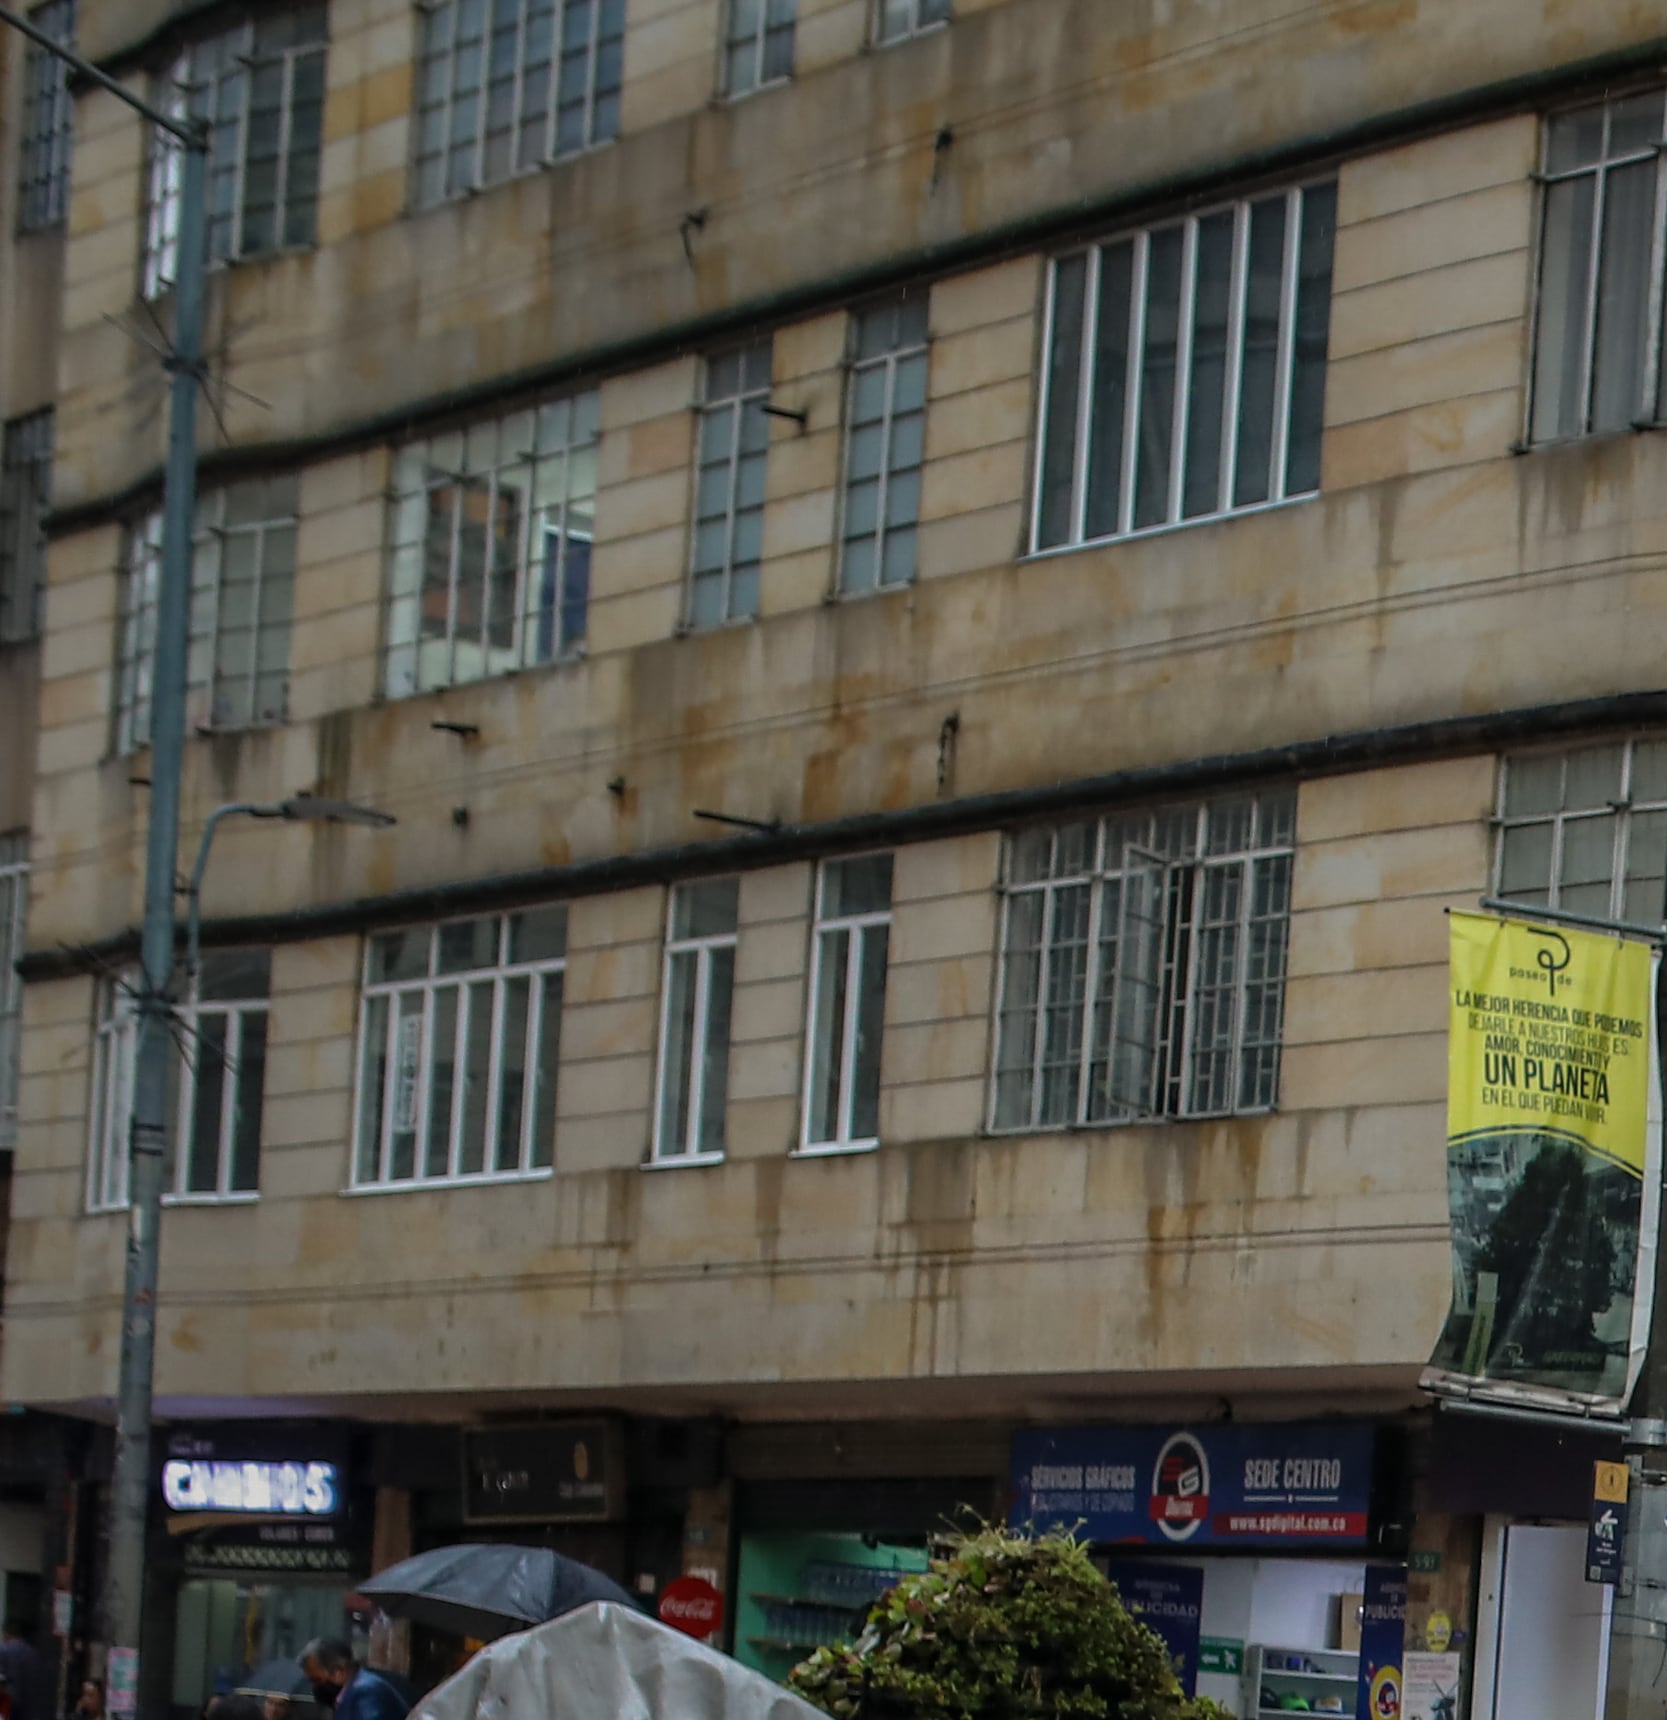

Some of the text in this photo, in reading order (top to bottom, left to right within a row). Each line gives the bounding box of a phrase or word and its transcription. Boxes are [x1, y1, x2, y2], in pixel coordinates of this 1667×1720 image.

[1509, 966, 1573, 986] paseo de
[1455, 989, 1471, 1006] LA
[1512, 999, 1569, 1022] HERENCIA
[1571, 1008, 1592, 1027] QUE
[1468, 1011, 1514, 1034] DEJARLE
[1518, 1021, 1527, 1036] A
[1528, 1023, 1586, 1047] NUESTROS
[1484, 1053, 1610, 1105] UN PLANETA
[1482, 1087, 1499, 1104] EN
[1501, 1090, 1515, 1106] EL
[1518, 1093, 1541, 1111] QUE
[1543, 1096, 1584, 1119] PUEDAN
[1243, 1458, 1341, 1490] SEDE CENTRO
